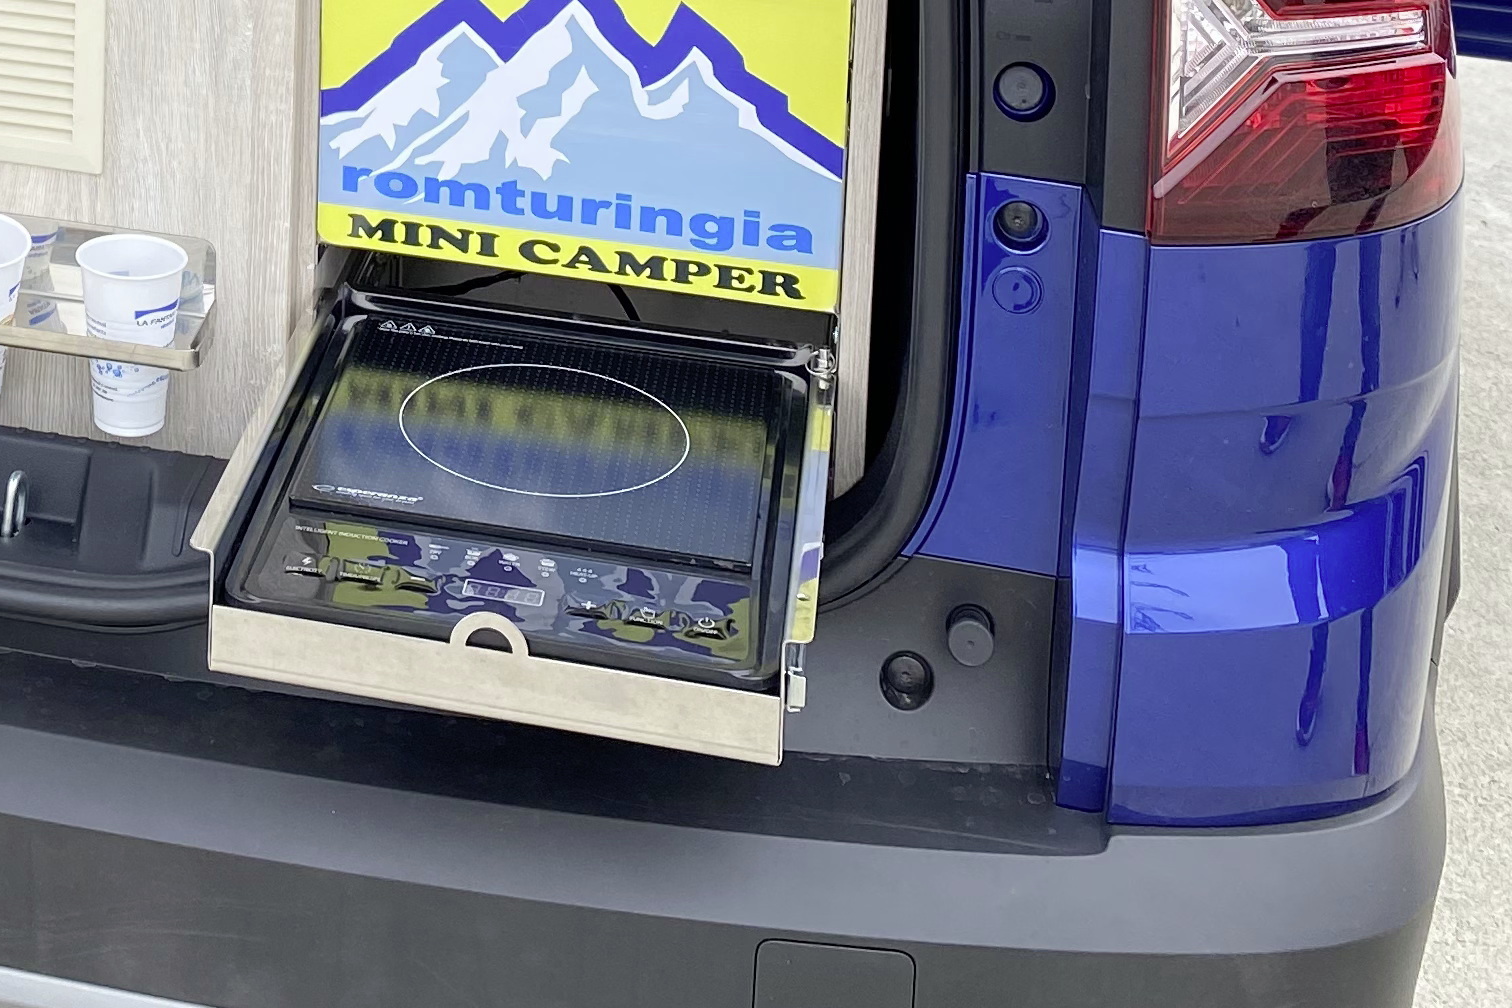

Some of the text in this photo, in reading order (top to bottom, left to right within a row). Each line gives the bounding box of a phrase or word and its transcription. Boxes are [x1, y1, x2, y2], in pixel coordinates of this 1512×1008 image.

[341, 163, 814, 255] romturingia
[347, 213, 806, 300] MINI CAMPER
[295, 525, 408, 546] INTELLIGENT INDUCTION COOKER
[629, 616, 664, 626] FUNCTION
